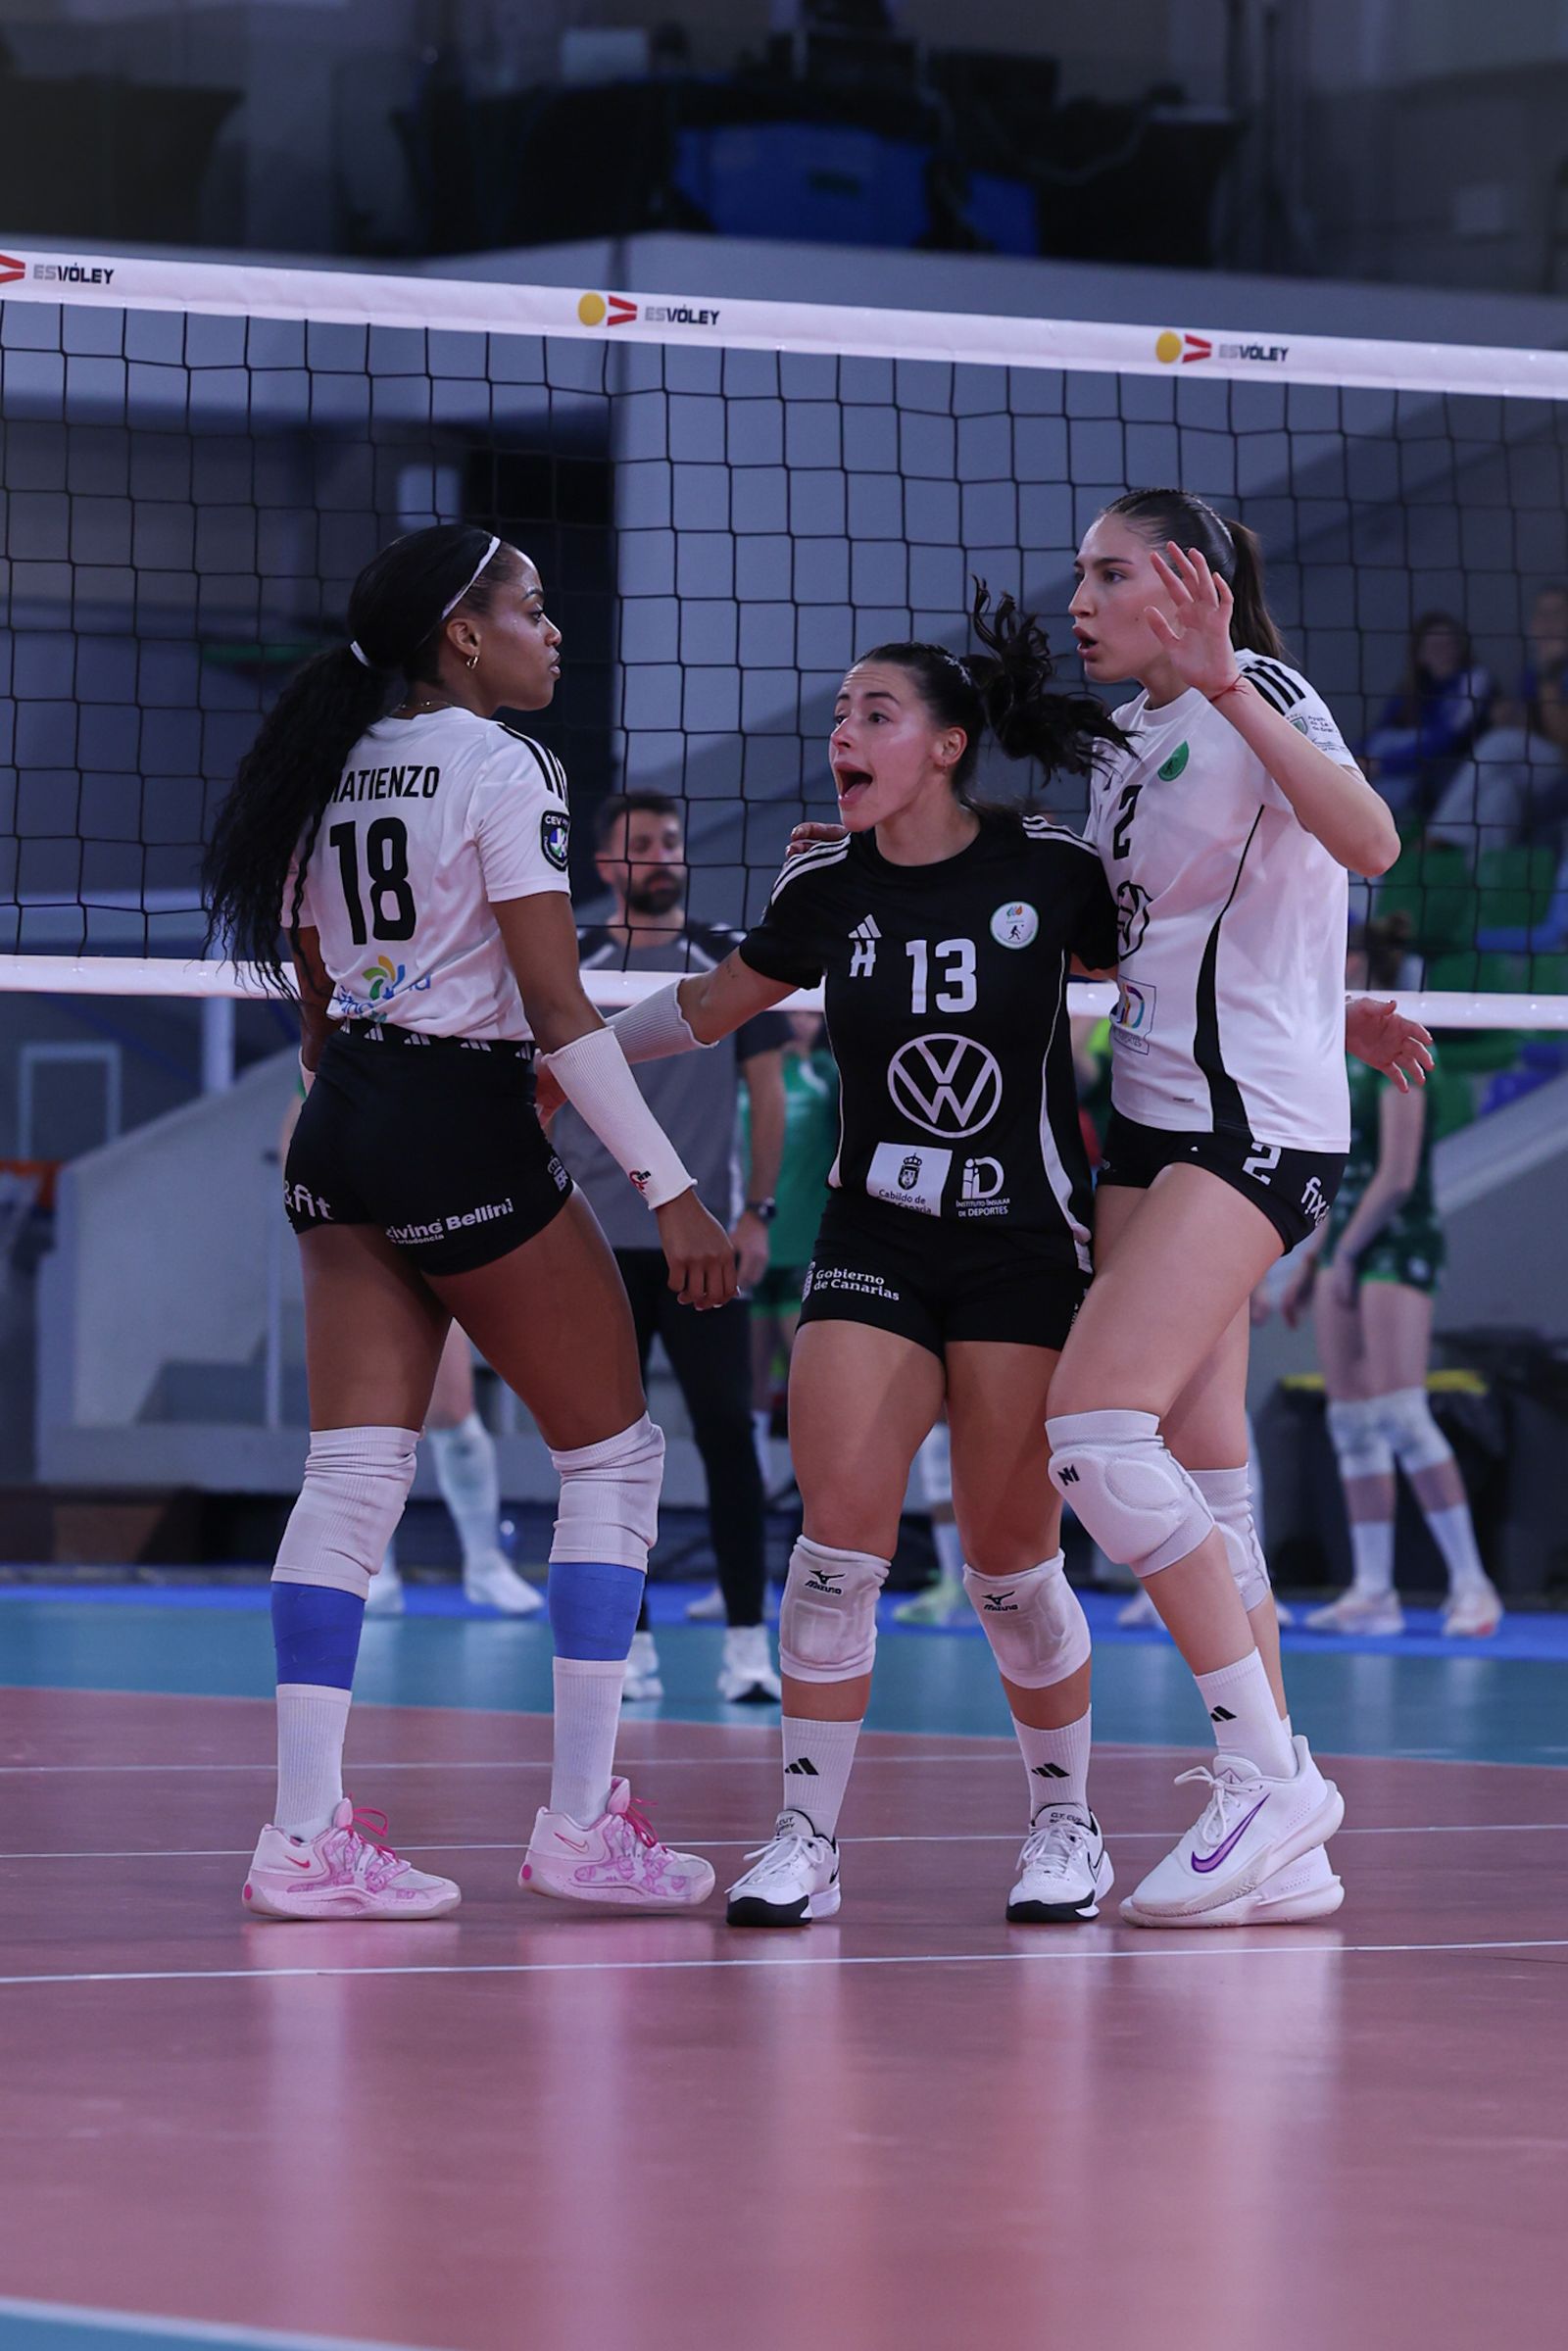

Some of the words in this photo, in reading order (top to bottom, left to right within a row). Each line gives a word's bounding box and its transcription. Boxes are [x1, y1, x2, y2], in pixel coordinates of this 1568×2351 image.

[33, 262, 115, 284] ESVÓLEY
[644, 304, 720, 325] ESVÓLEY
[1113, 784, 1144, 860] 2
[329, 816, 416, 946] 18
[906, 938, 977, 1014] 13
[1242, 1142, 1282, 1186] 2
[878, 1189, 912, 1204] Cabildo
[914, 1195, 926, 1205] de
[967, 1205, 1008, 1217] DEPORTES
[815, 1268, 885, 1286] Gobierno
[813, 1280, 828, 1291] de
[830, 1278, 900, 1300] Canarias
